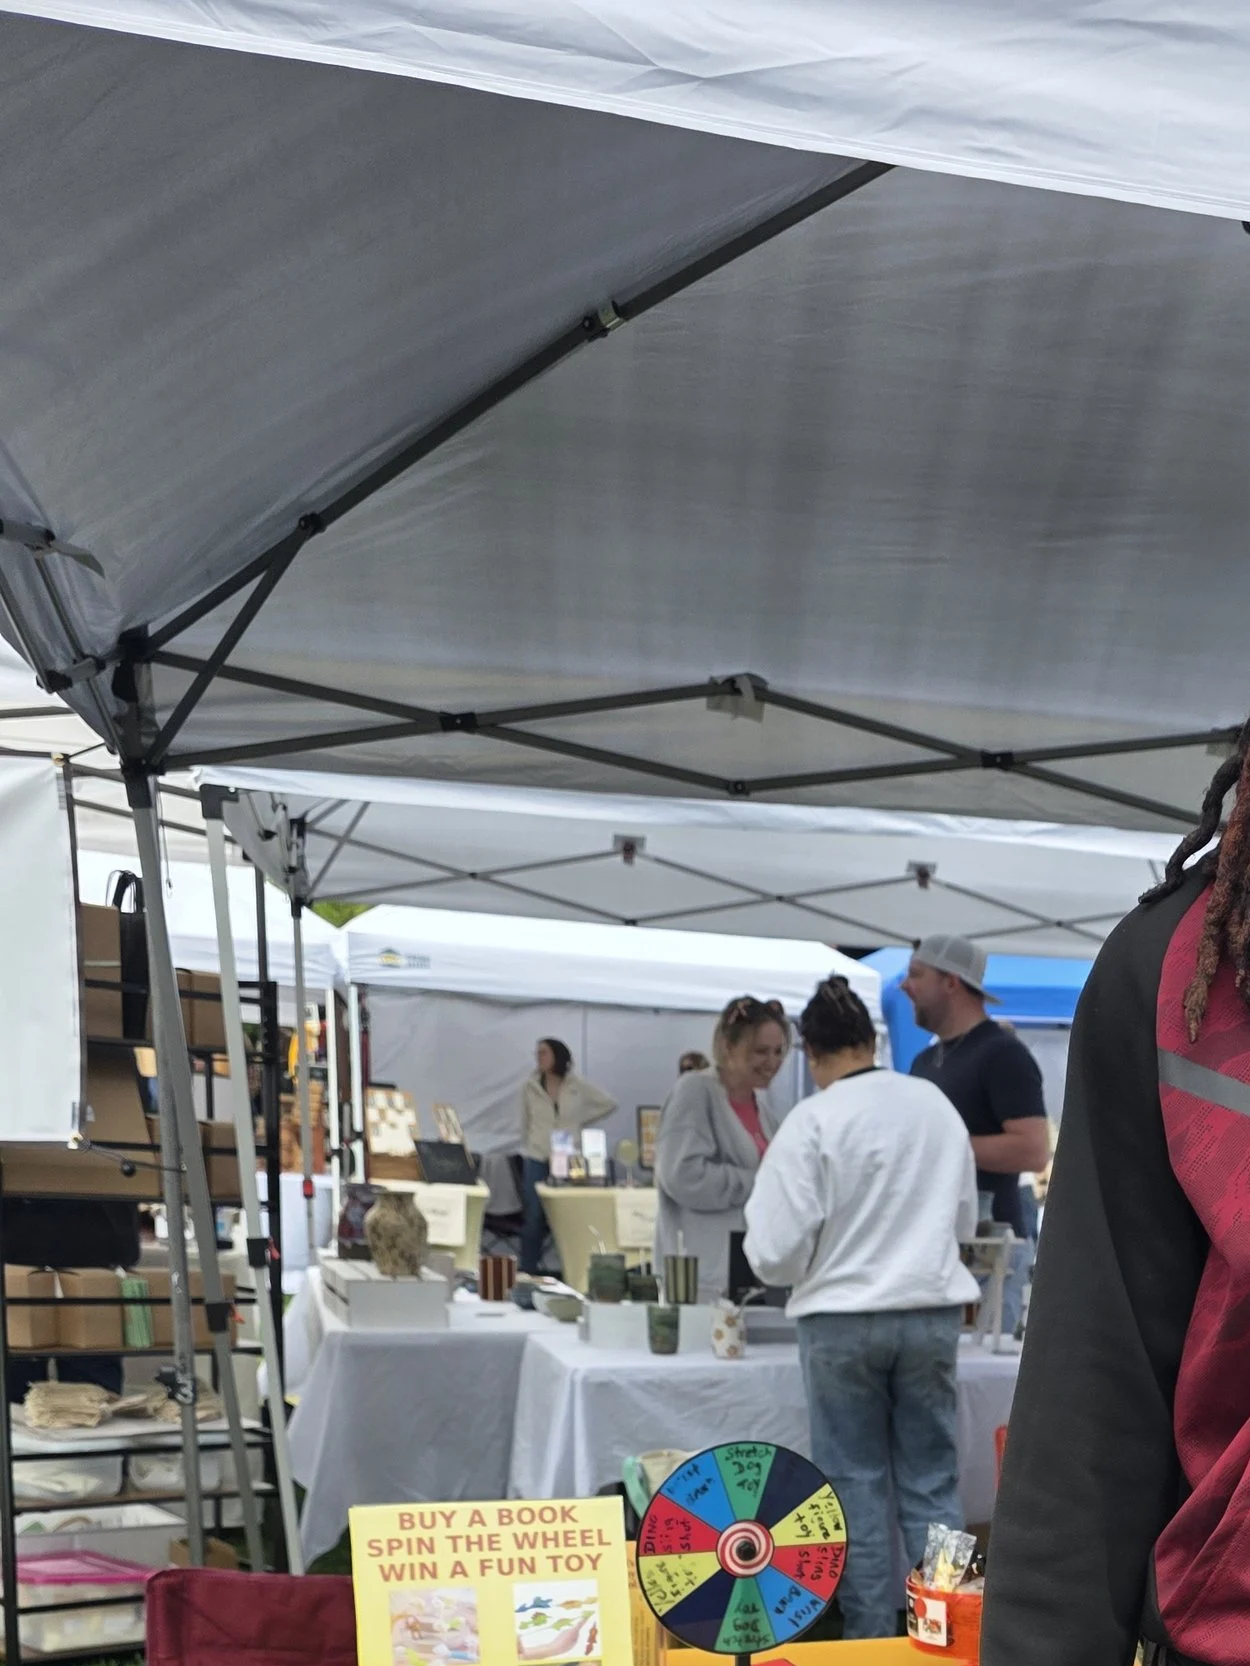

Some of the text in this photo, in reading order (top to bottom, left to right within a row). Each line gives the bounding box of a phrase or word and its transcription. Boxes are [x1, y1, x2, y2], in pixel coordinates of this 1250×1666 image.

[398, 1505, 580, 1532] BUY A BOOK
[367, 1528, 612, 1558] SPIN THE WHEEL
[378, 1553, 604, 1583] WIN A FUN TOY
